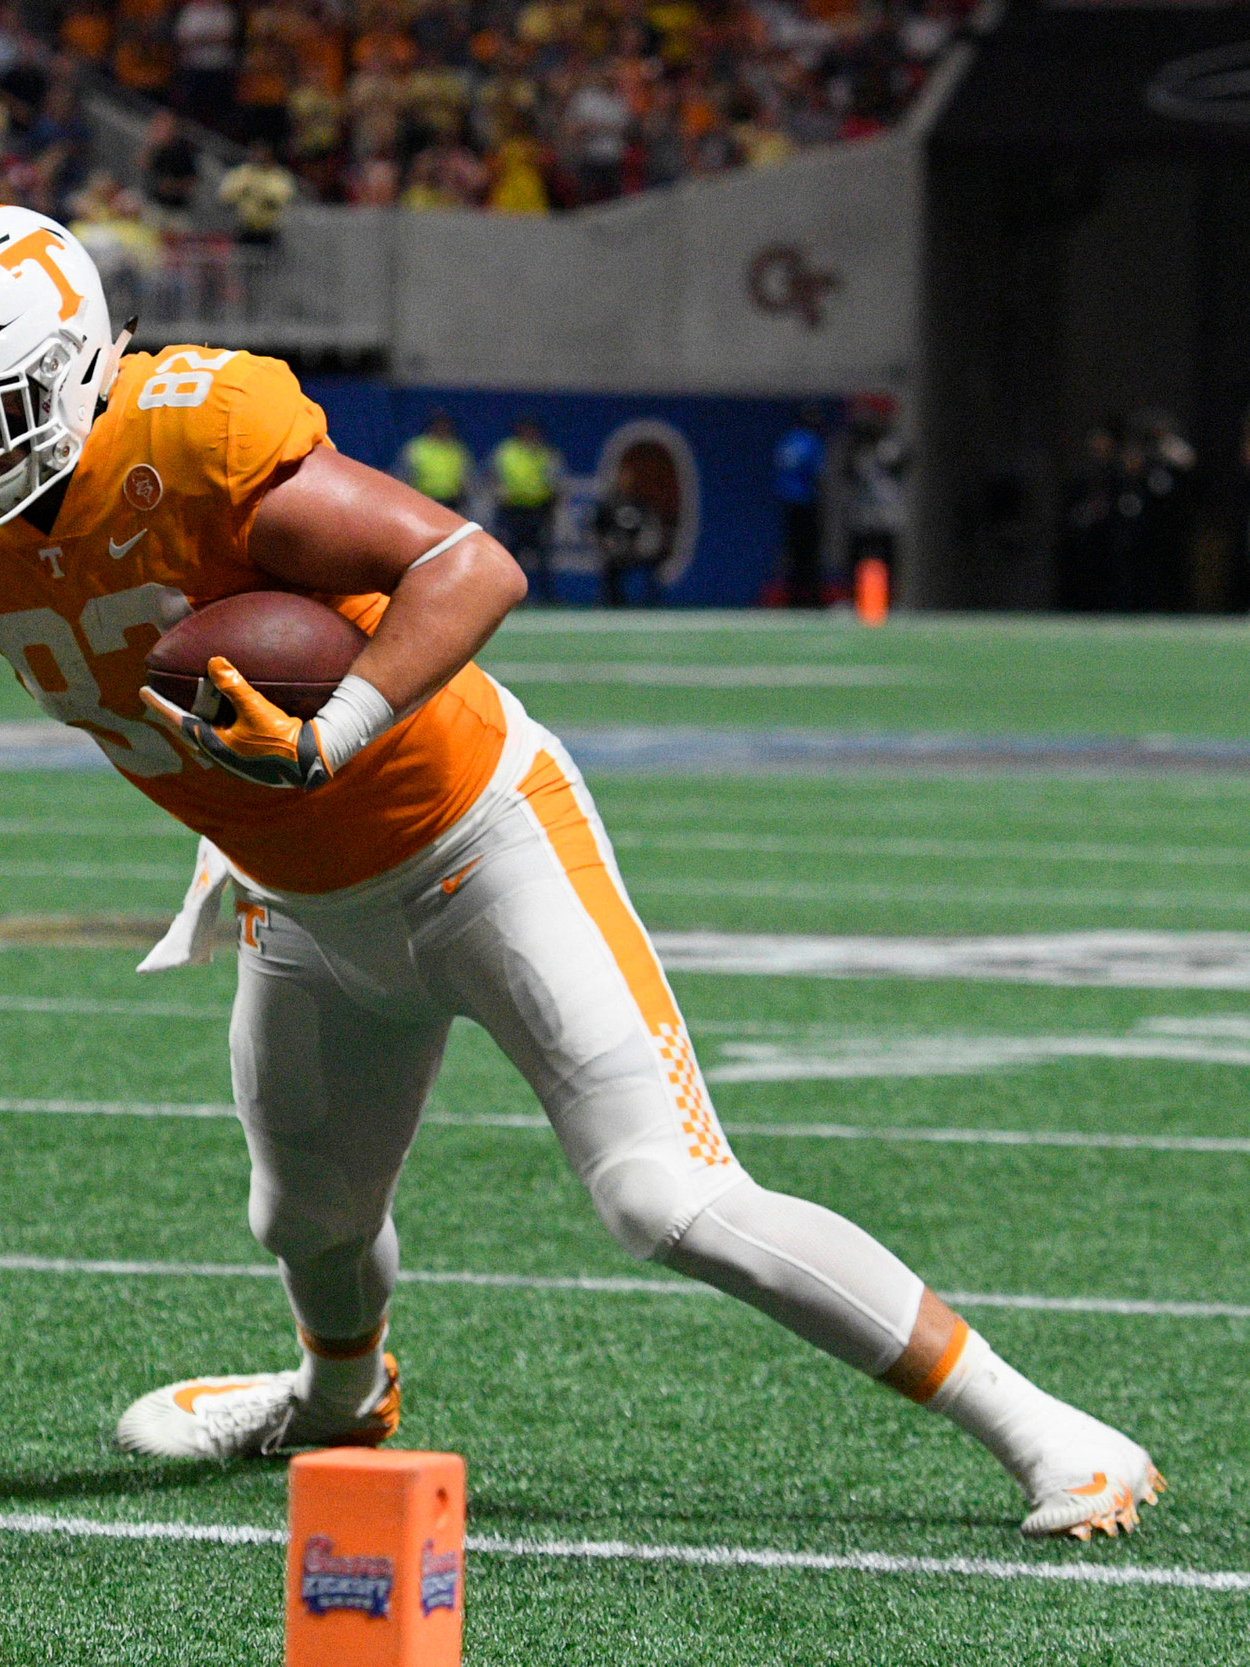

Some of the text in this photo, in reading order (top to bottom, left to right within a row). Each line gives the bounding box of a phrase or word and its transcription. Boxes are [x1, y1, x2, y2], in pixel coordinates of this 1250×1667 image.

[137, 350, 239, 411] 82
[39, 546, 66, 580] T
[236, 900, 268, 949] T
